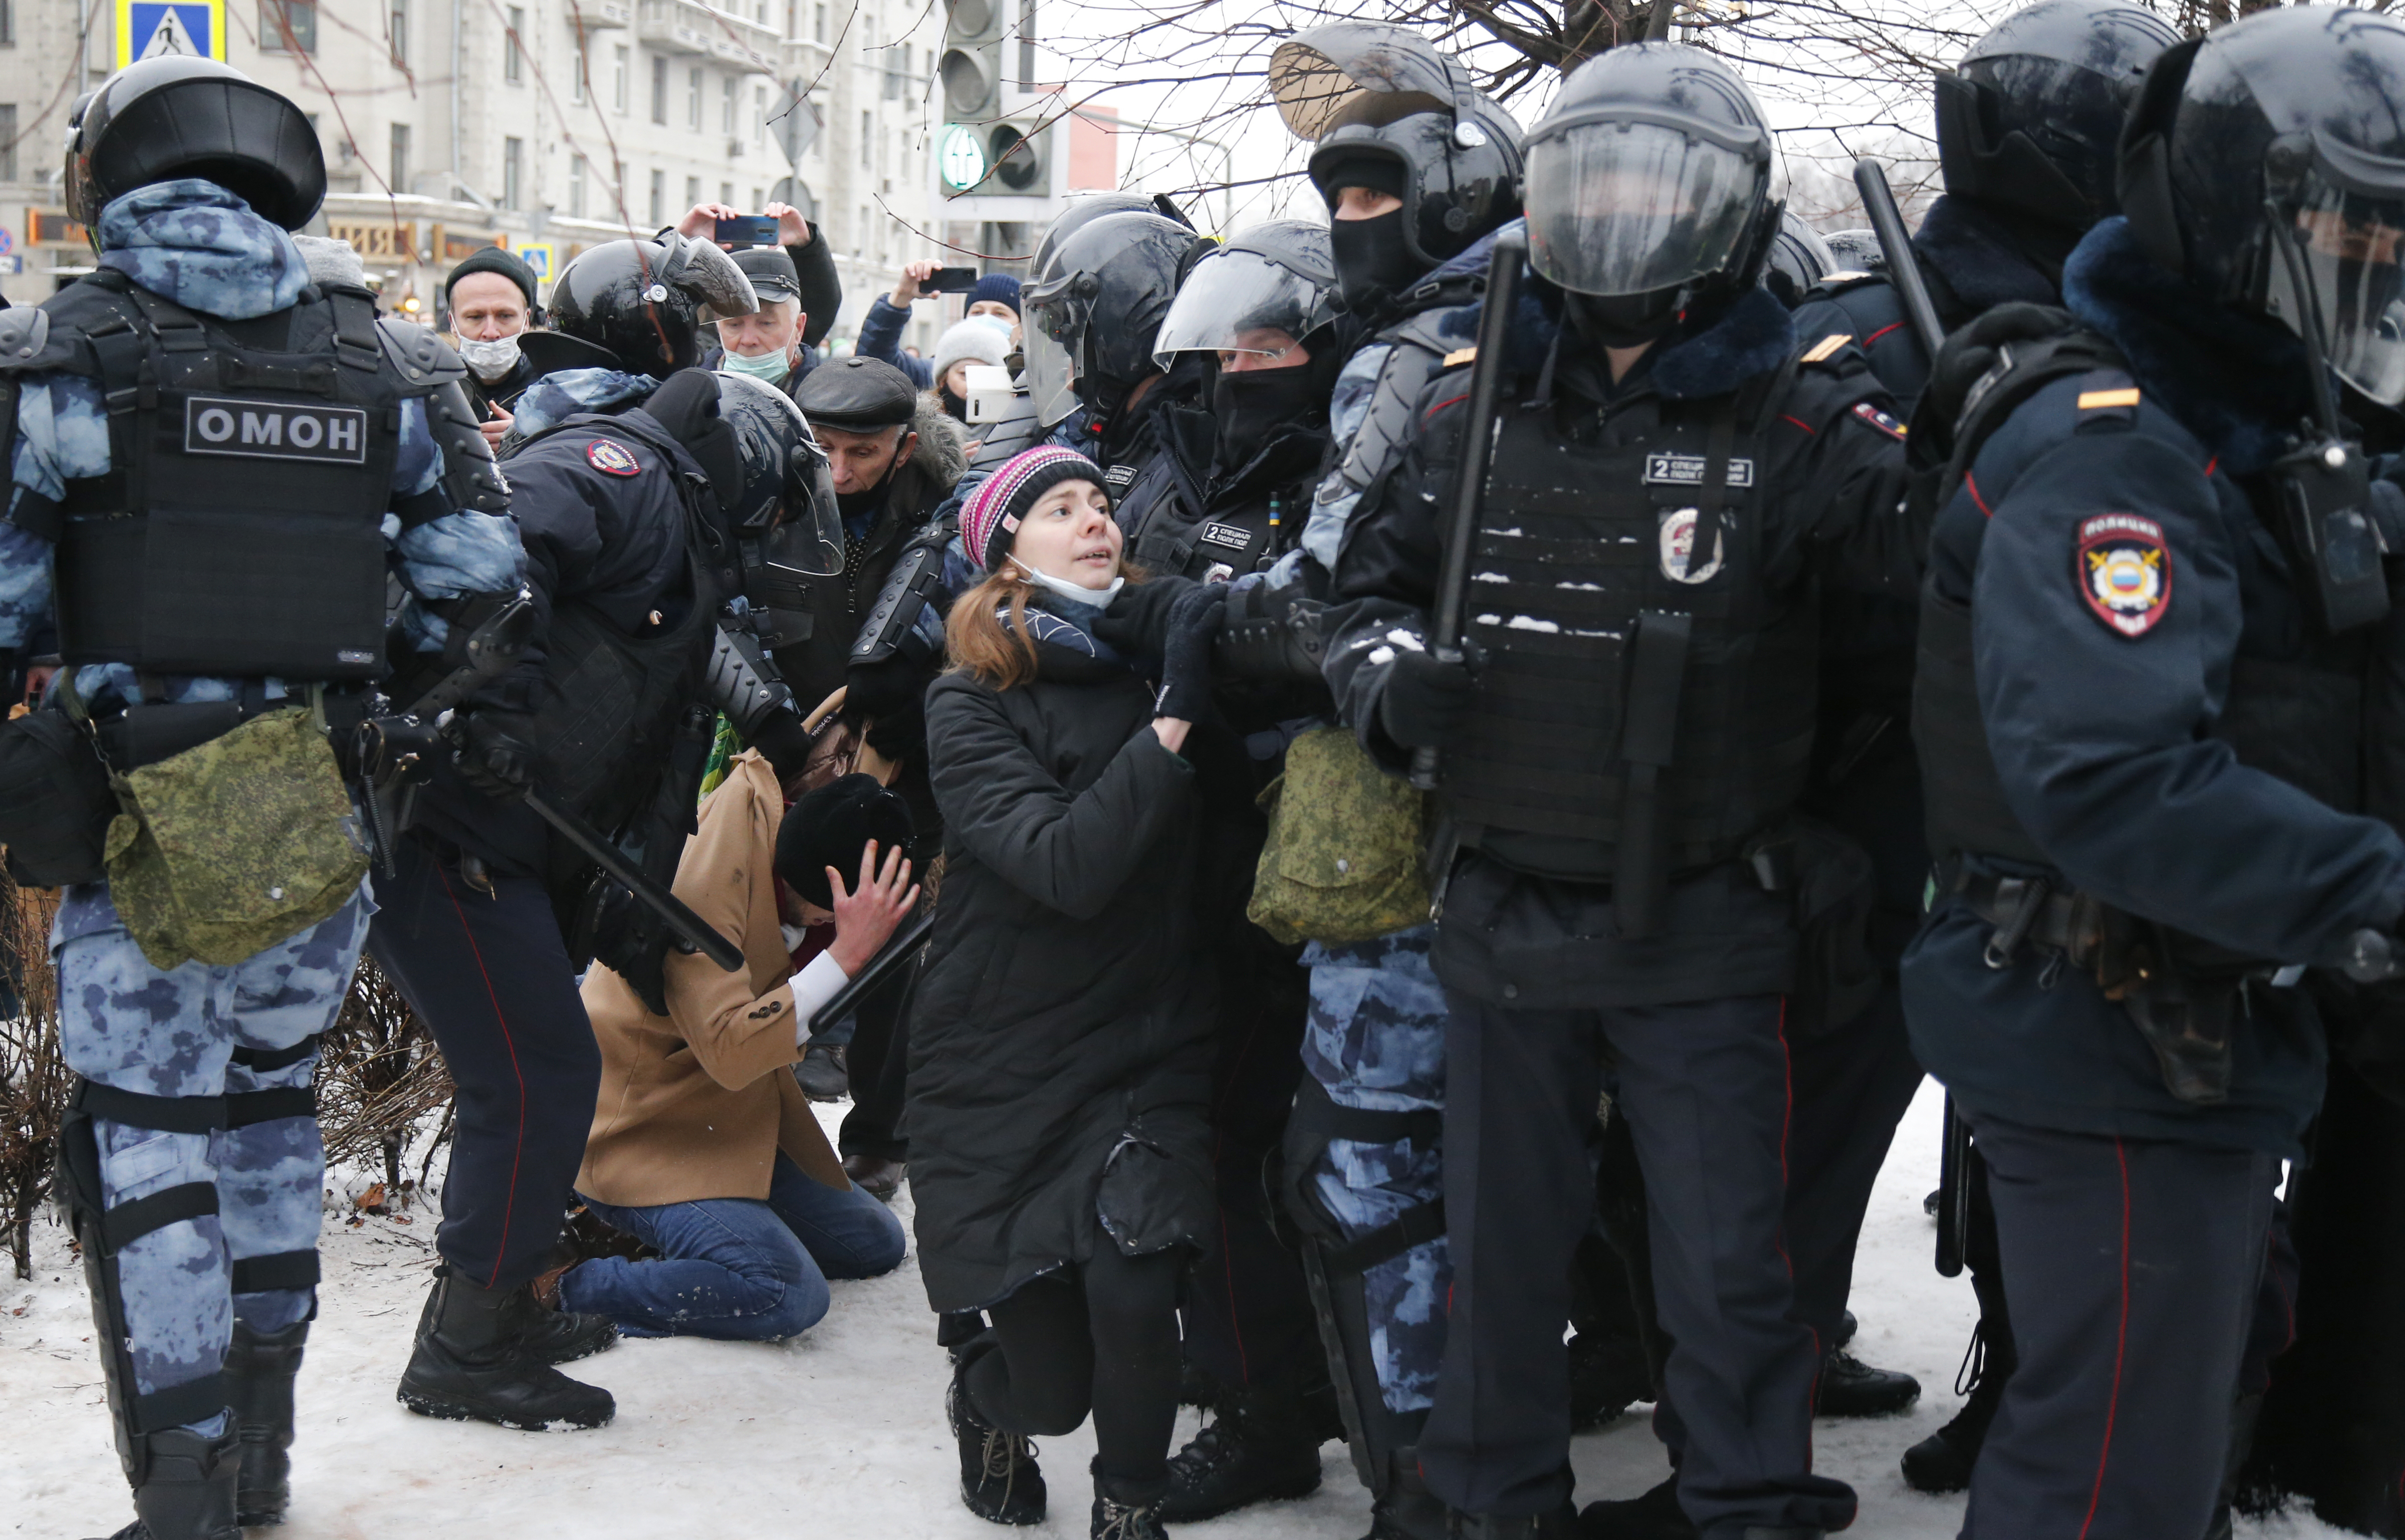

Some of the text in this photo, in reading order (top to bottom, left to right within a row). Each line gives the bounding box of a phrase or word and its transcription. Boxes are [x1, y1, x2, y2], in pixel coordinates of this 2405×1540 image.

[198, 408, 357, 451] ОМОН
[591, 456, 608, 469] МВД
[602, 439, 639, 470] ПОЛИЦИЯ
[1654, 459, 1669, 478] 2
[1207, 526, 1219, 540] 2
[2085, 516, 2159, 538] ПОЛИЦИЯ
[1216, 534, 1235, 544] ПОЛК
